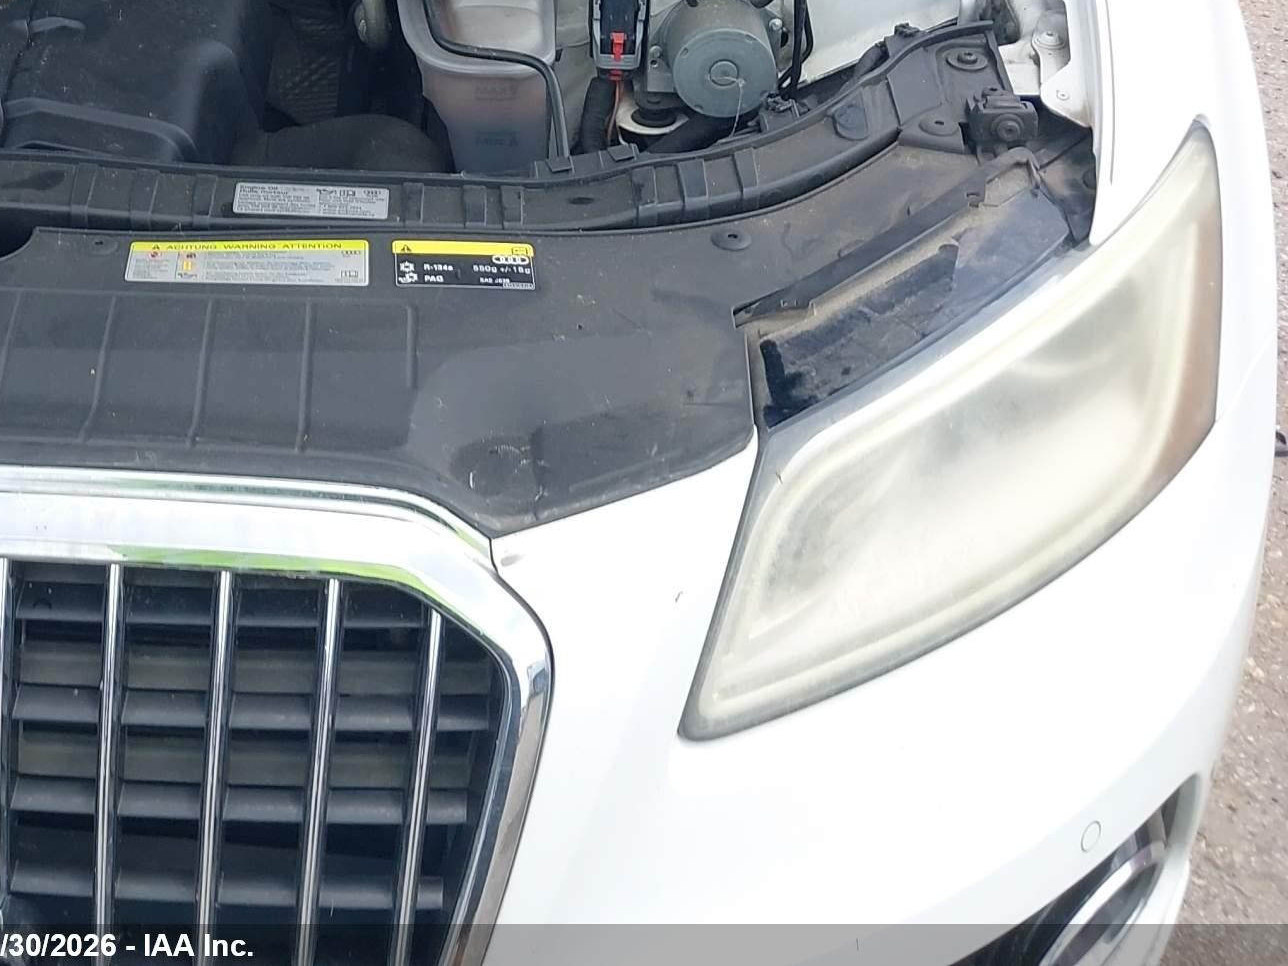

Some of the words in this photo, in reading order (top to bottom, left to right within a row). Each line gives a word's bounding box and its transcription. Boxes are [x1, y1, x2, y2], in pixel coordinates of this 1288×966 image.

[223, 242, 276, 250] WARNING
[423, 263, 453, 271] R-134a
[424, 274, 443, 282] PAG
